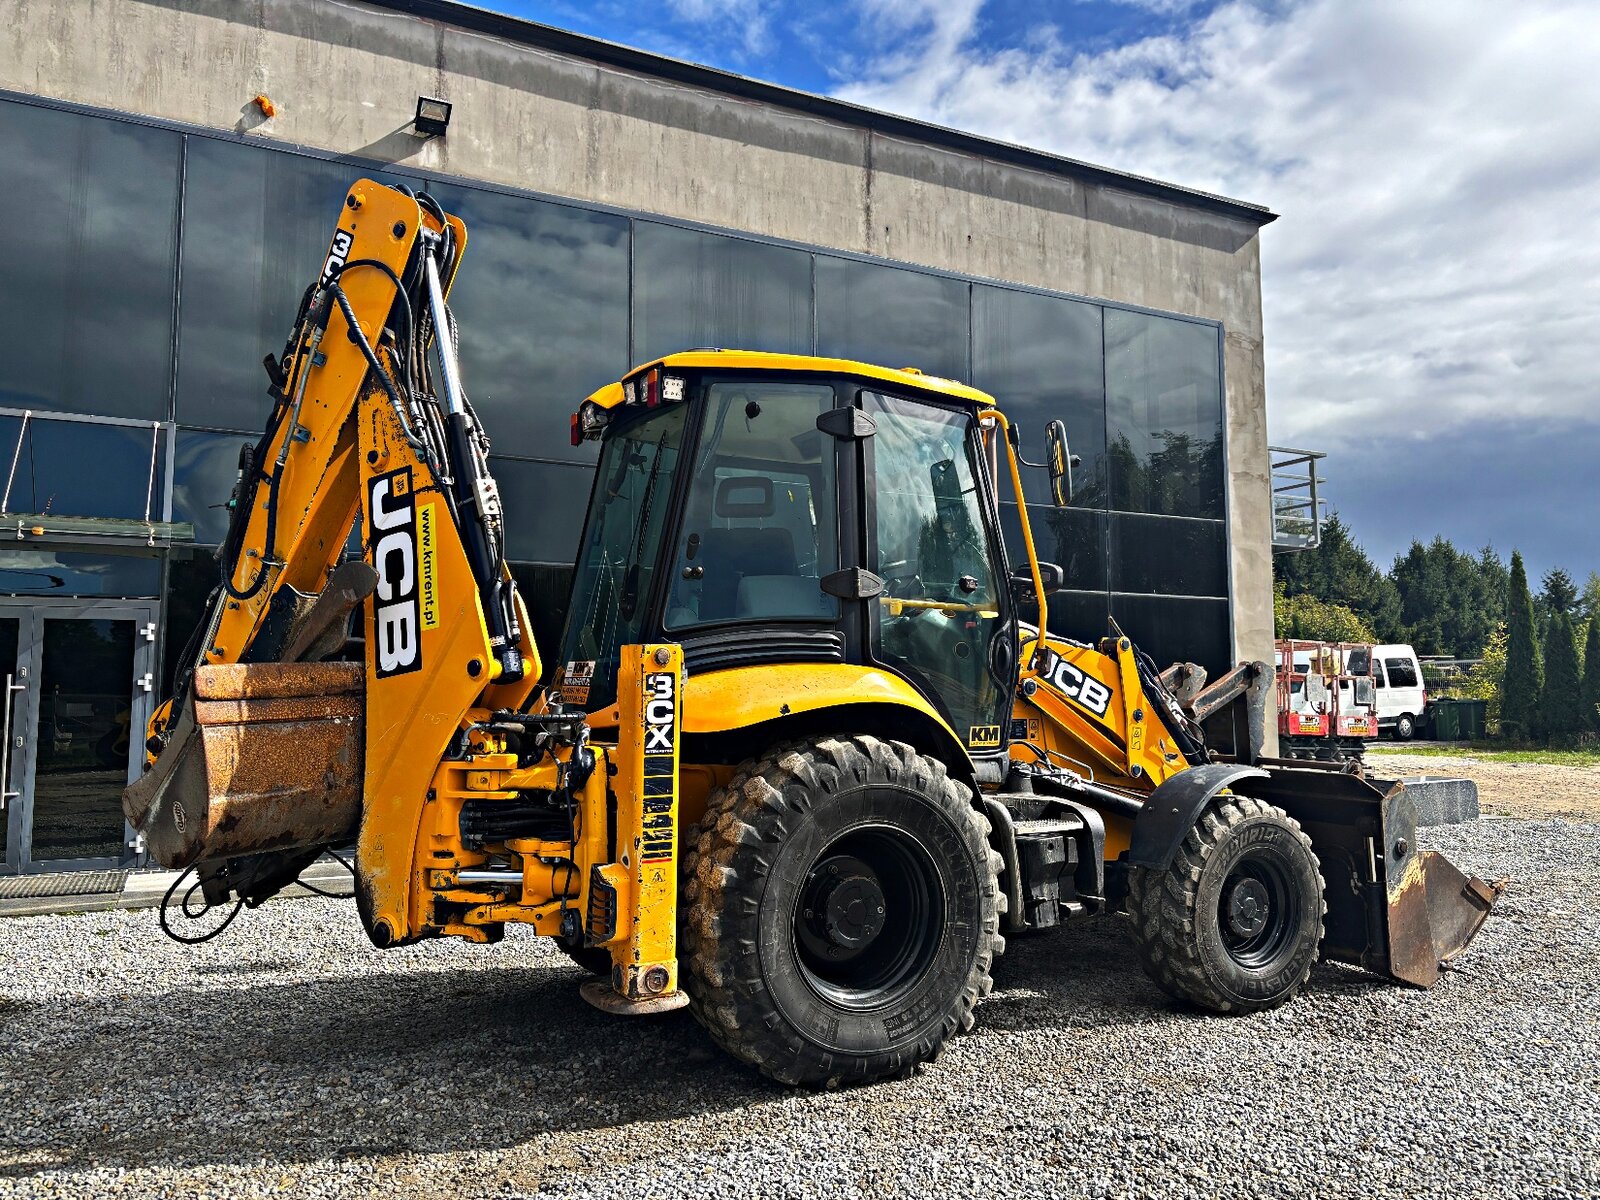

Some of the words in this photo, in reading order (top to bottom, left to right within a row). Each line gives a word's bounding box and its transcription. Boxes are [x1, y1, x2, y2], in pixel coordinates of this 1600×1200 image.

[372, 478, 417, 672] JCB
[419, 507, 437, 626] www.kmrent.pl
[646, 675, 674, 749] 3CX
[971, 727, 999, 741] KM
